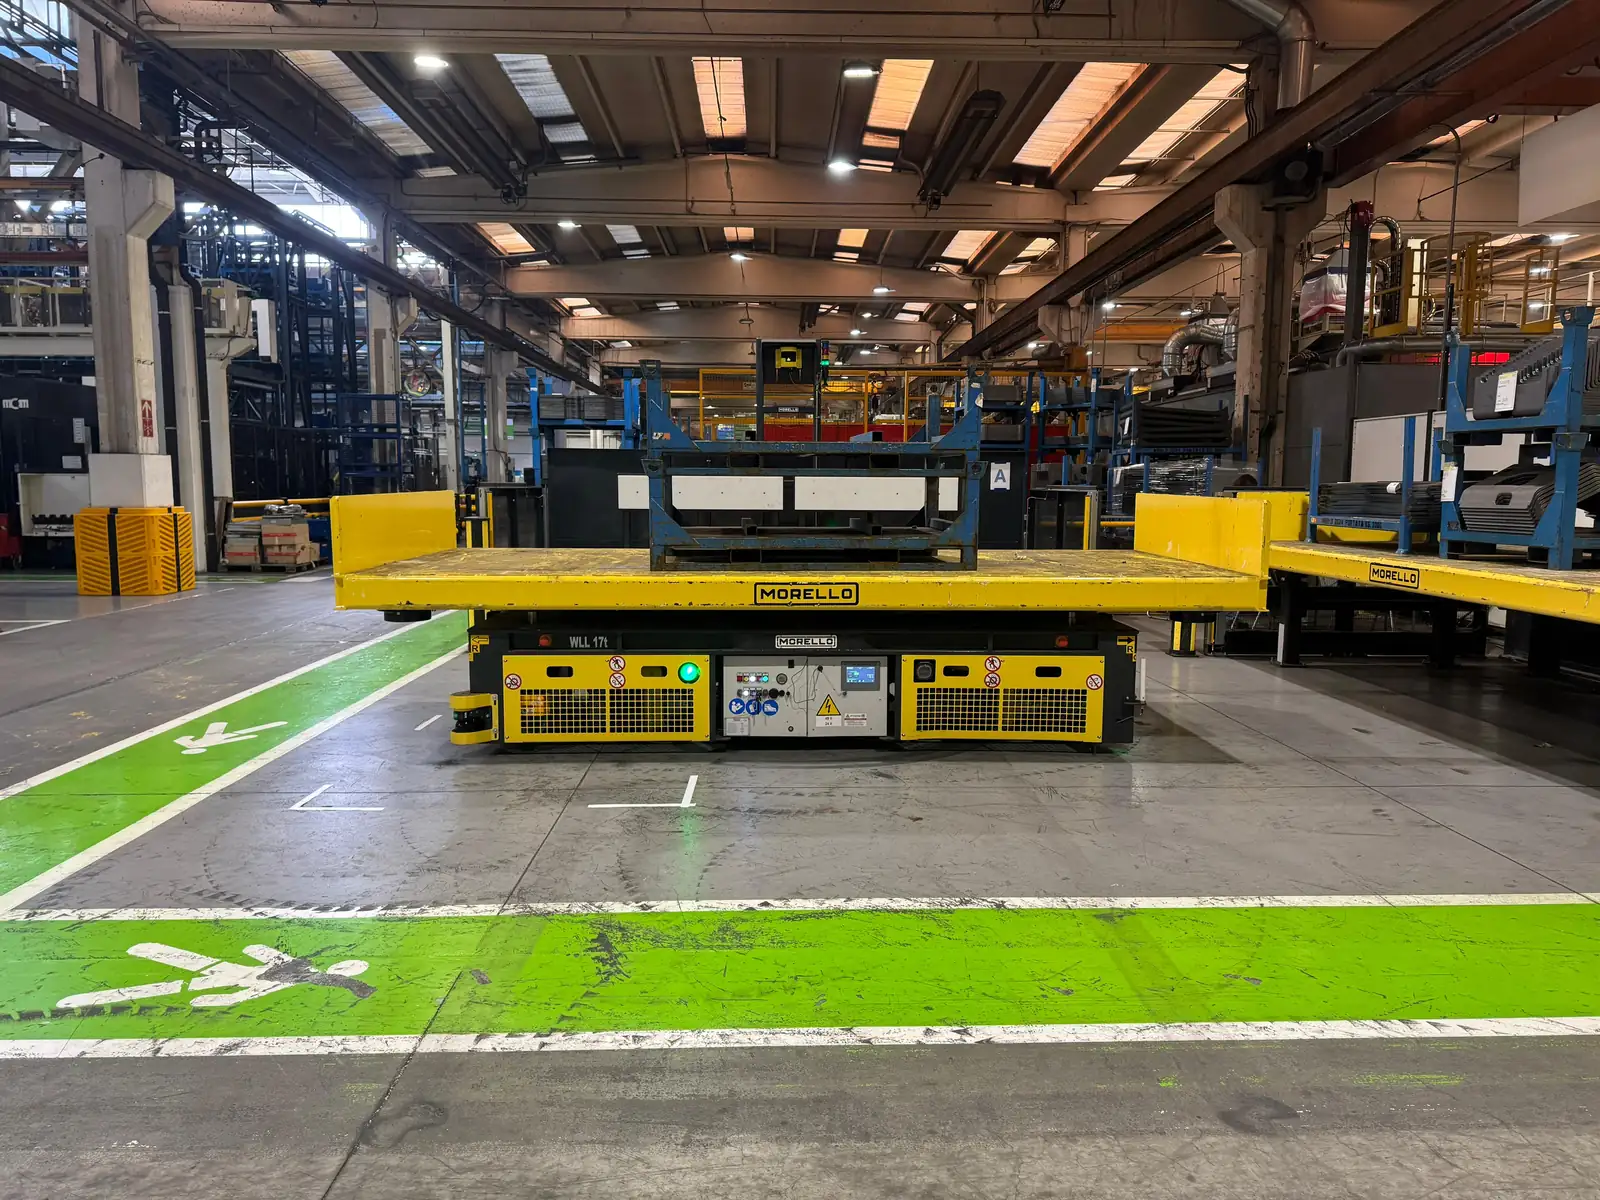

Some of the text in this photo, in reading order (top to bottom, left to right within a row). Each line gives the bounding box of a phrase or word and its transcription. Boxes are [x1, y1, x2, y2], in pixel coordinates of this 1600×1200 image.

[994, 469, 1006, 482] A
[1372, 568, 1416, 583] MORELLO
[760, 588, 853, 600] MORELLO
[569, 636, 608, 648] WLL 17t
